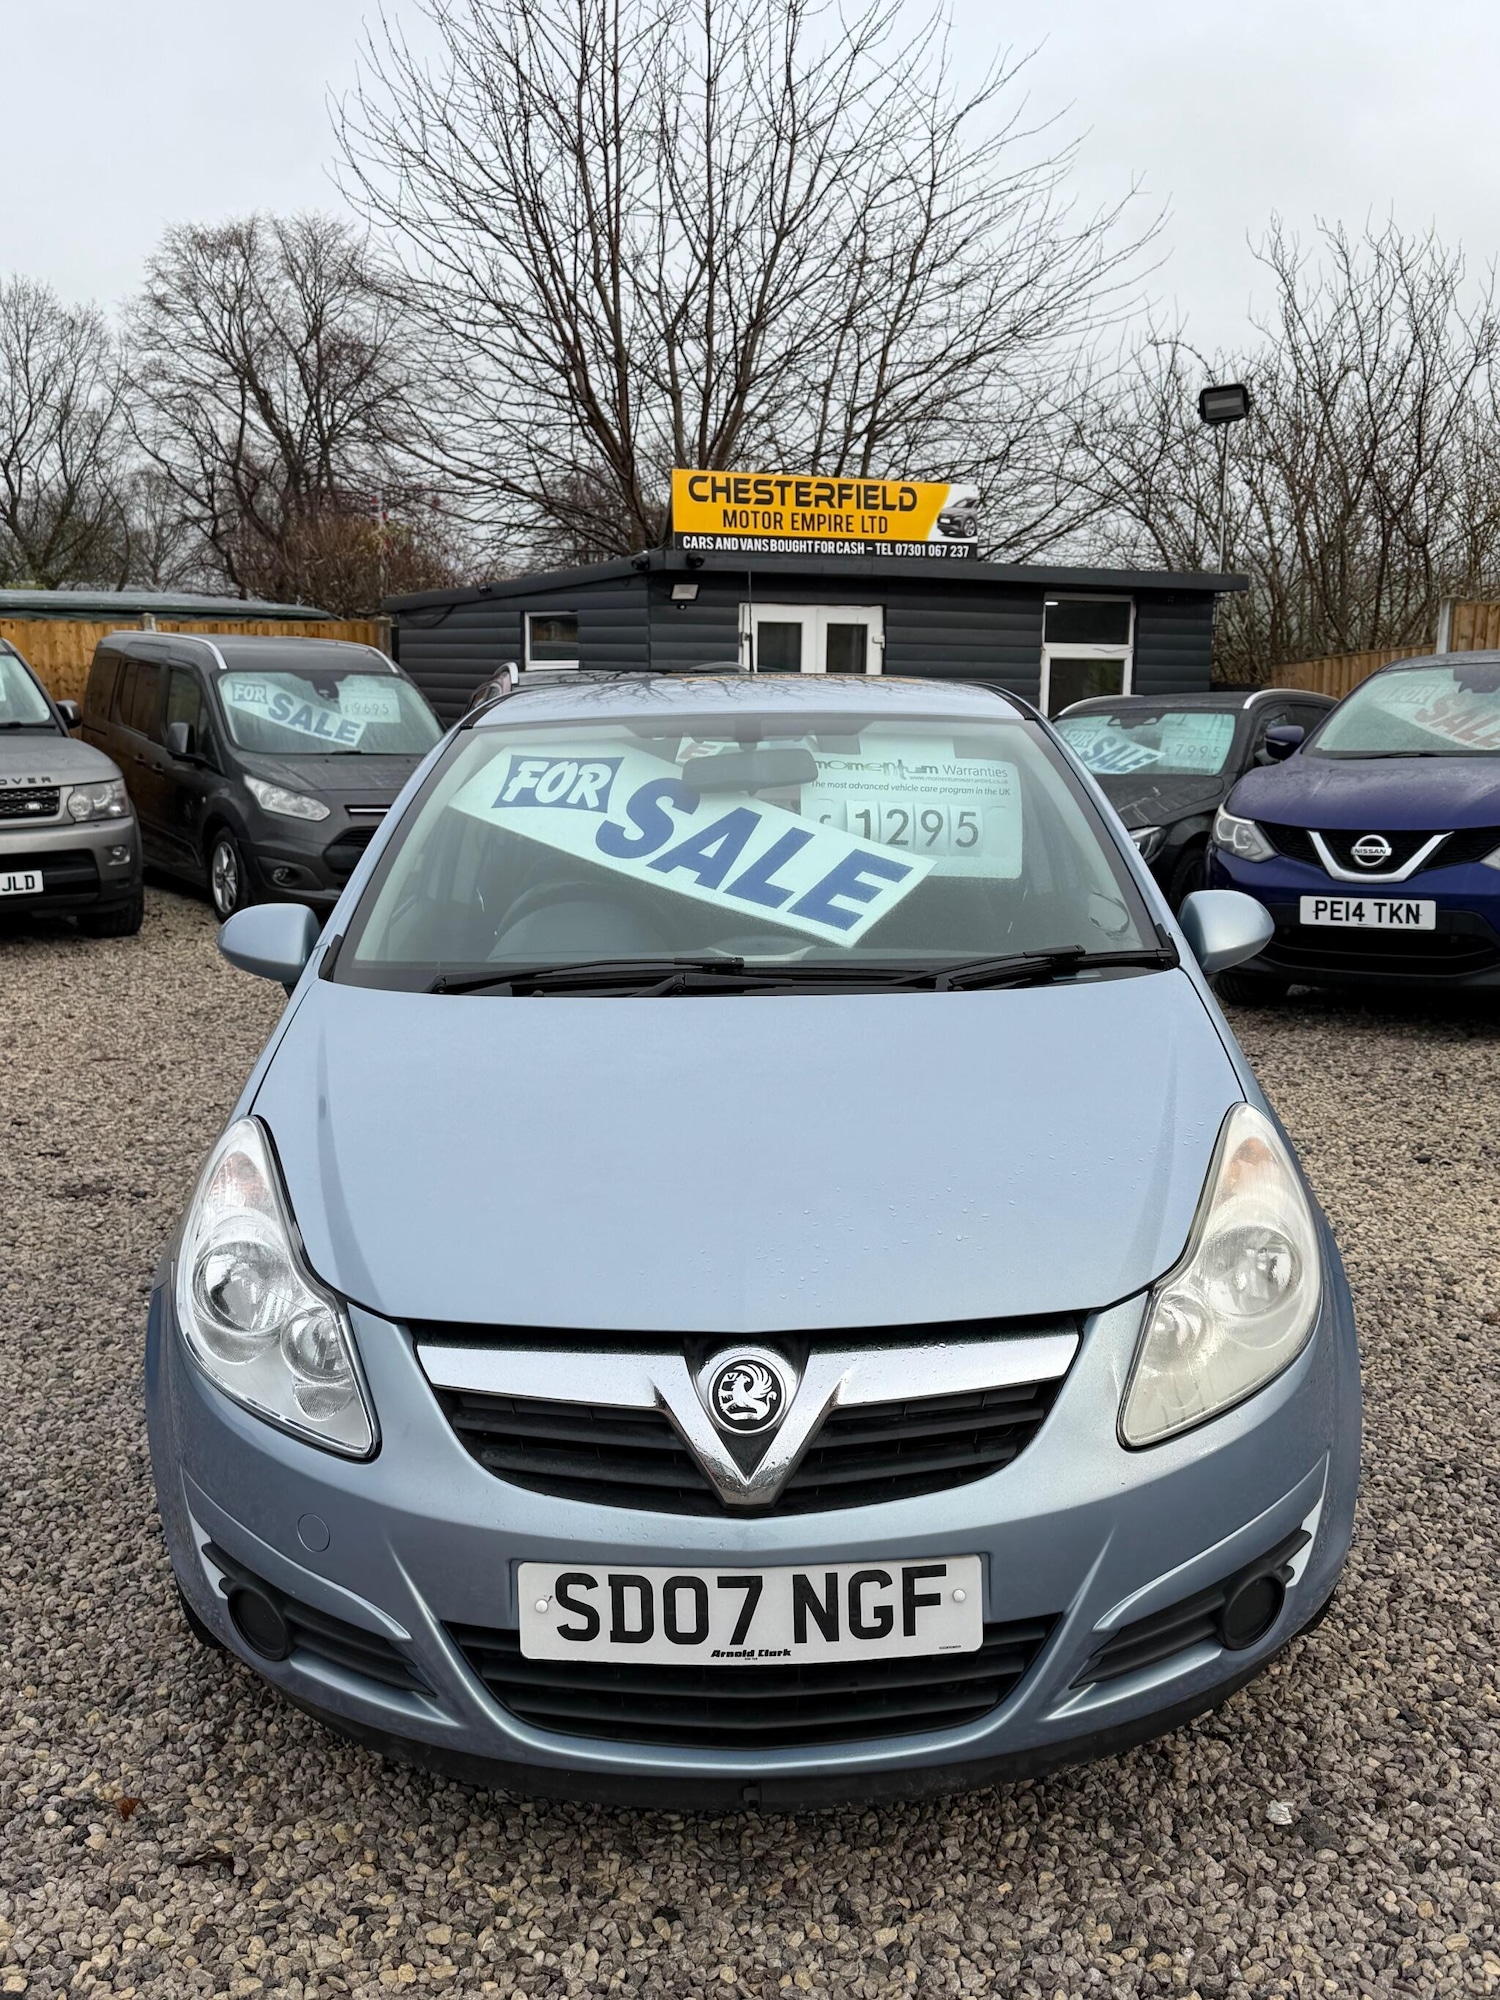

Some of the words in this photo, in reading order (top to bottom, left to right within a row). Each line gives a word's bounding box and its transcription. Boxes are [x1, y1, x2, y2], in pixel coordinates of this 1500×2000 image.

[688, 475, 918, 512] CHESTERFIELD
[722, 509, 784, 530] MOTOR
[791, 512, 854, 533] EMPIRE
[861, 515, 888, 534] LTD
[682, 535, 714, 550] CARS
[715, 537, 738, 550] AND
[739, 538, 770, 552] VANS
[770, 539, 813, 554] BOUGHT
[813, 541, 836, 554] FOR
[836, 541, 865, 555] CASH
[875, 543, 896, 556] TEL
[895, 544, 926, 557] 07301
[928, 544, 947, 558] 067
[950, 545, 969, 558] 237
[234, 685, 266, 702] FOR
[268, 693, 361, 743] SALE
[1081, 736, 1159, 772] SALE
[943, 764, 1008, 778] Warranties
[812, 780, 826, 788] The
[849, 782, 889, 791] advanced
[891, 783, 919, 792] vehicle
[939, 787, 974, 796] program
[975, 786, 983, 795] in
[984, 787, 997, 796] the
[999, 787, 1010, 796] UK
[501, 760, 612, 811] FOR
[595, 777, 914, 931] SALE
[2, 875, 35, 892] JLD
[1315, 900, 1365, 922] PE14
[1373, 903, 1421, 924] TKN
[555, 1571, 763, 1645] SD07
[792, 1564, 947, 1643] NGF
[711, 1649, 754, 1657] Arnold
[758, 1649, 791, 1657] Clark
